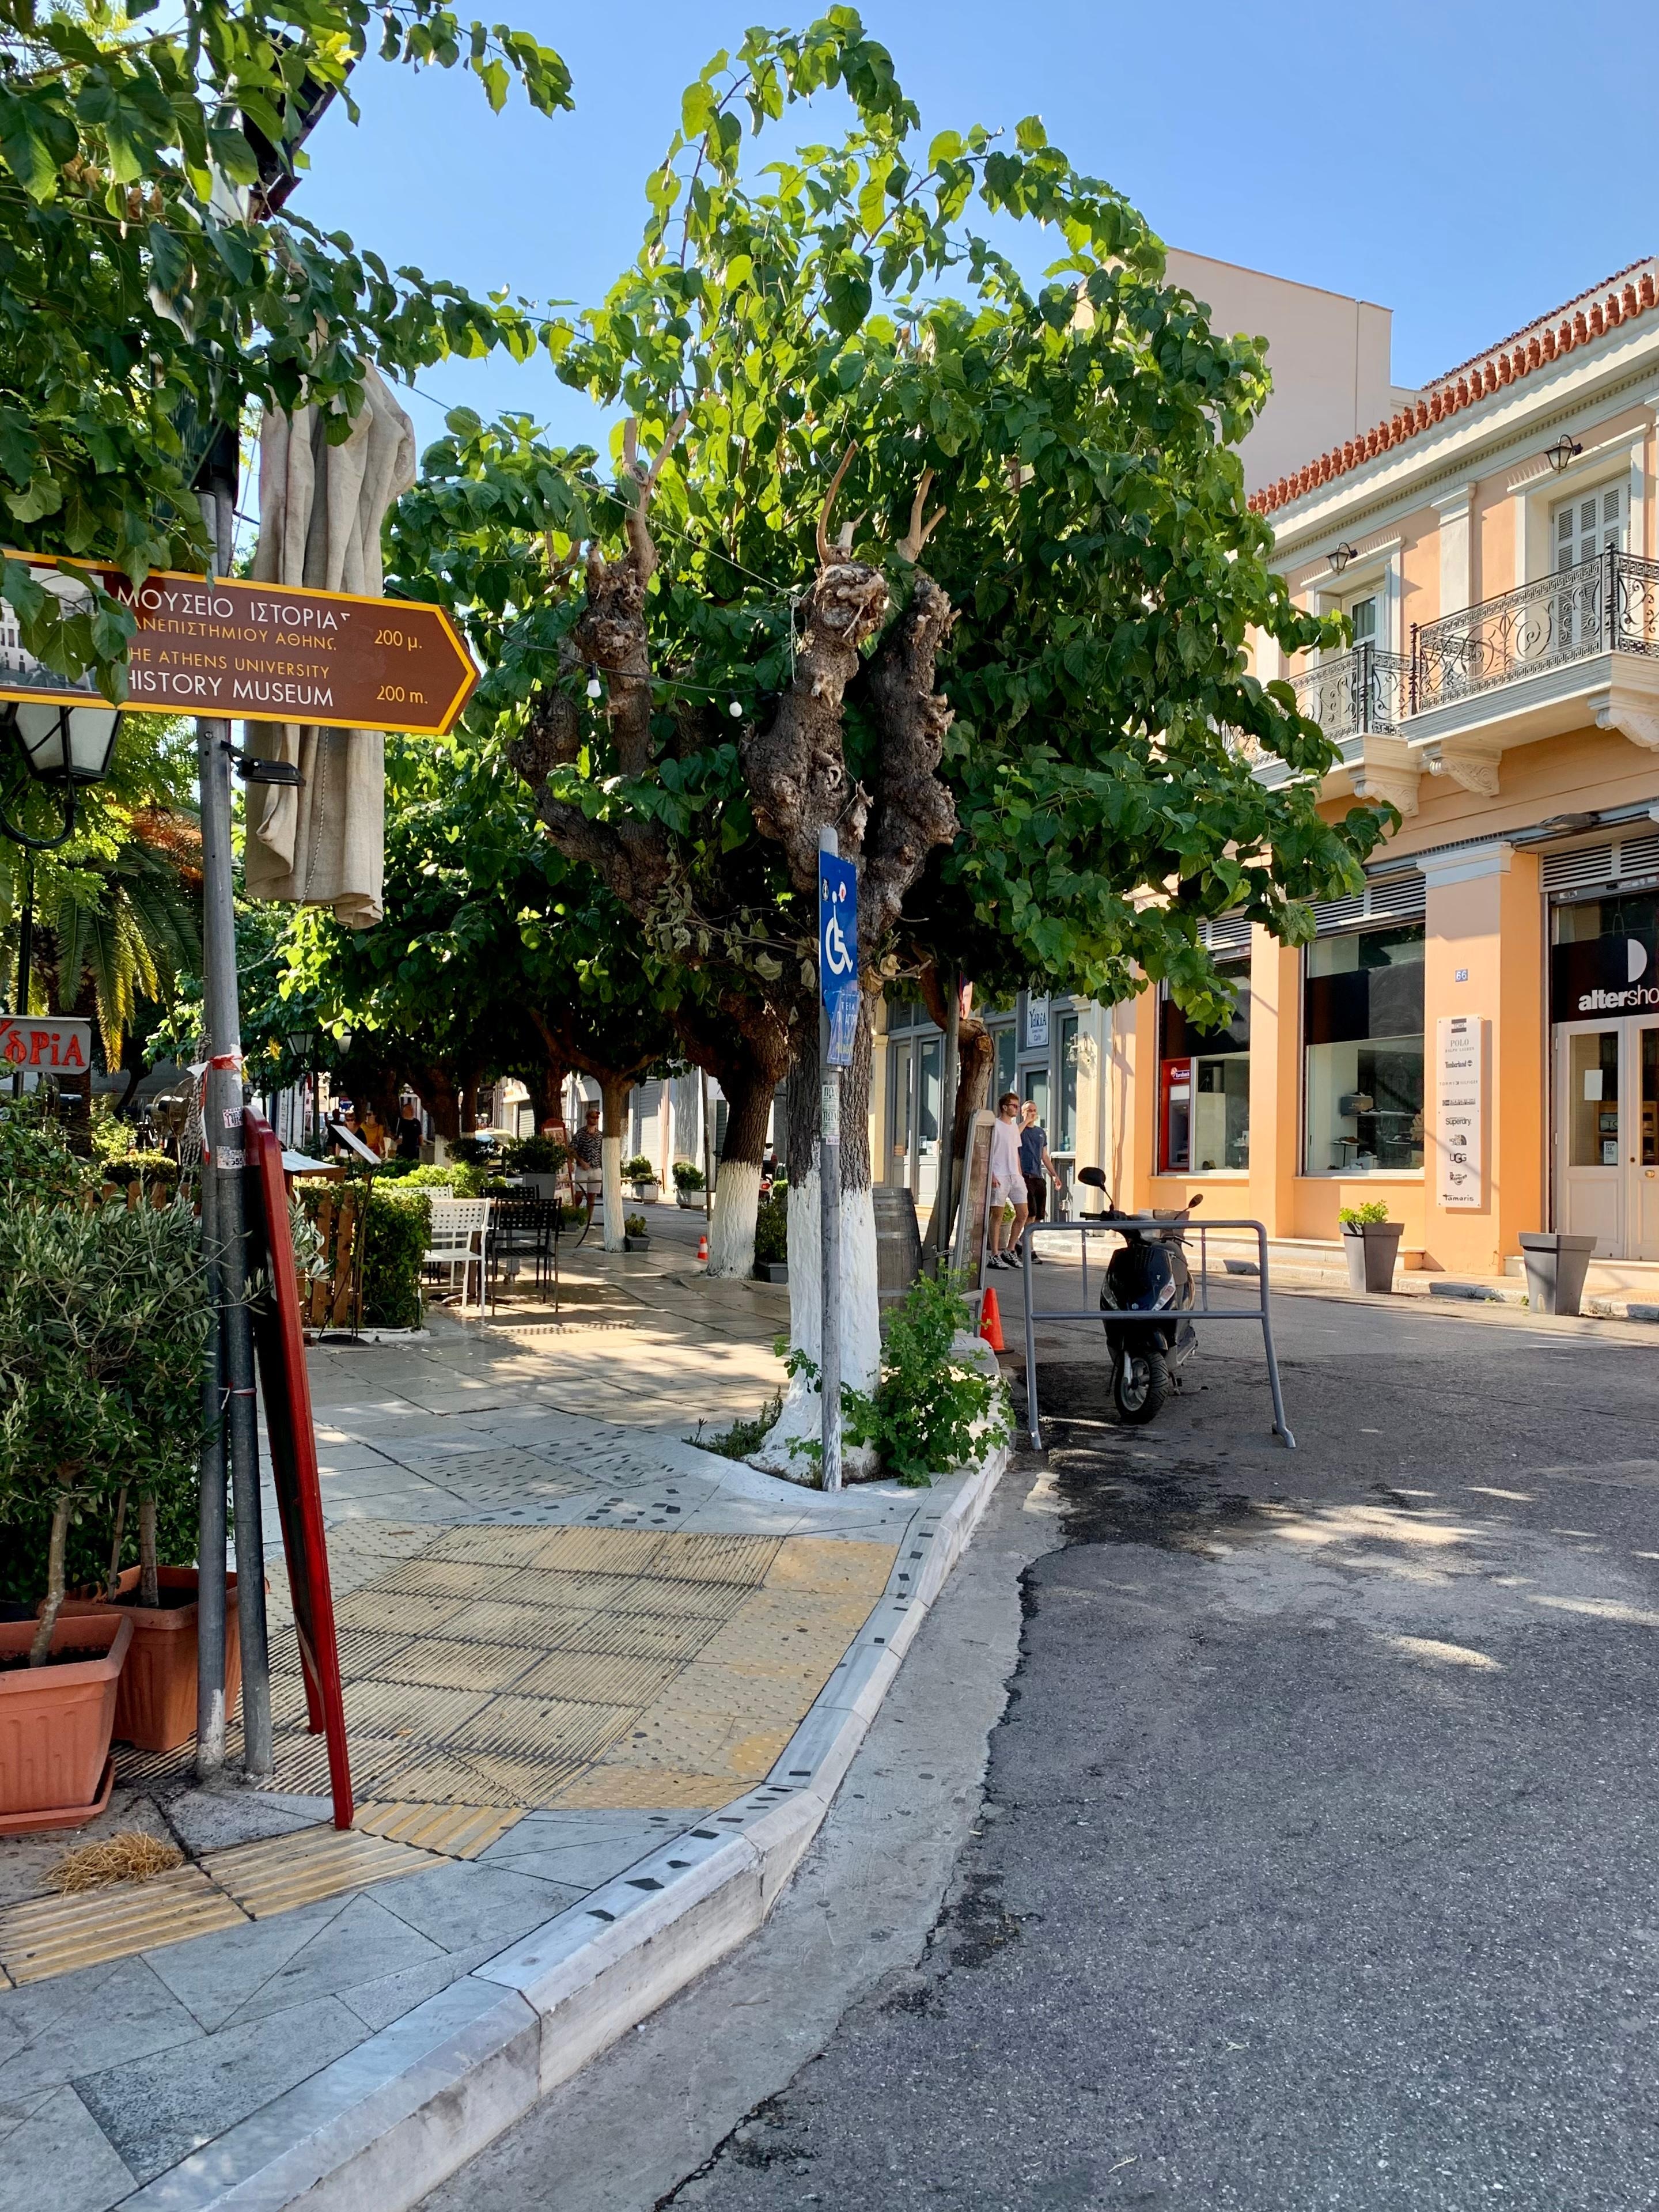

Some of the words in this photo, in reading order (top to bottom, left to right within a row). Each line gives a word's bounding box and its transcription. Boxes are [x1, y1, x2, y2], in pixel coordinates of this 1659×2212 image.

[117, 585, 233, 618] ΜΟΥΣΕΙΟ
[133, 616, 268, 643] ΑΝΕΠΙΣΤΗΜΙΟΥ
[374, 629, 403, 647] 200
[130, 647, 152, 662] HE
[158, 650, 228, 669] ATHENS
[234, 657, 329, 679] UNIVERSITY
[232, 678, 334, 707] MUSEUM
[376, 685, 405, 702] 200
[1456, 971, 1467, 980] 66
[1450, 1039, 1469, 1047] POLO
[1449, 1153, 1467, 1164] UGG
[1442, 1194, 1474, 1202] Tamaris
